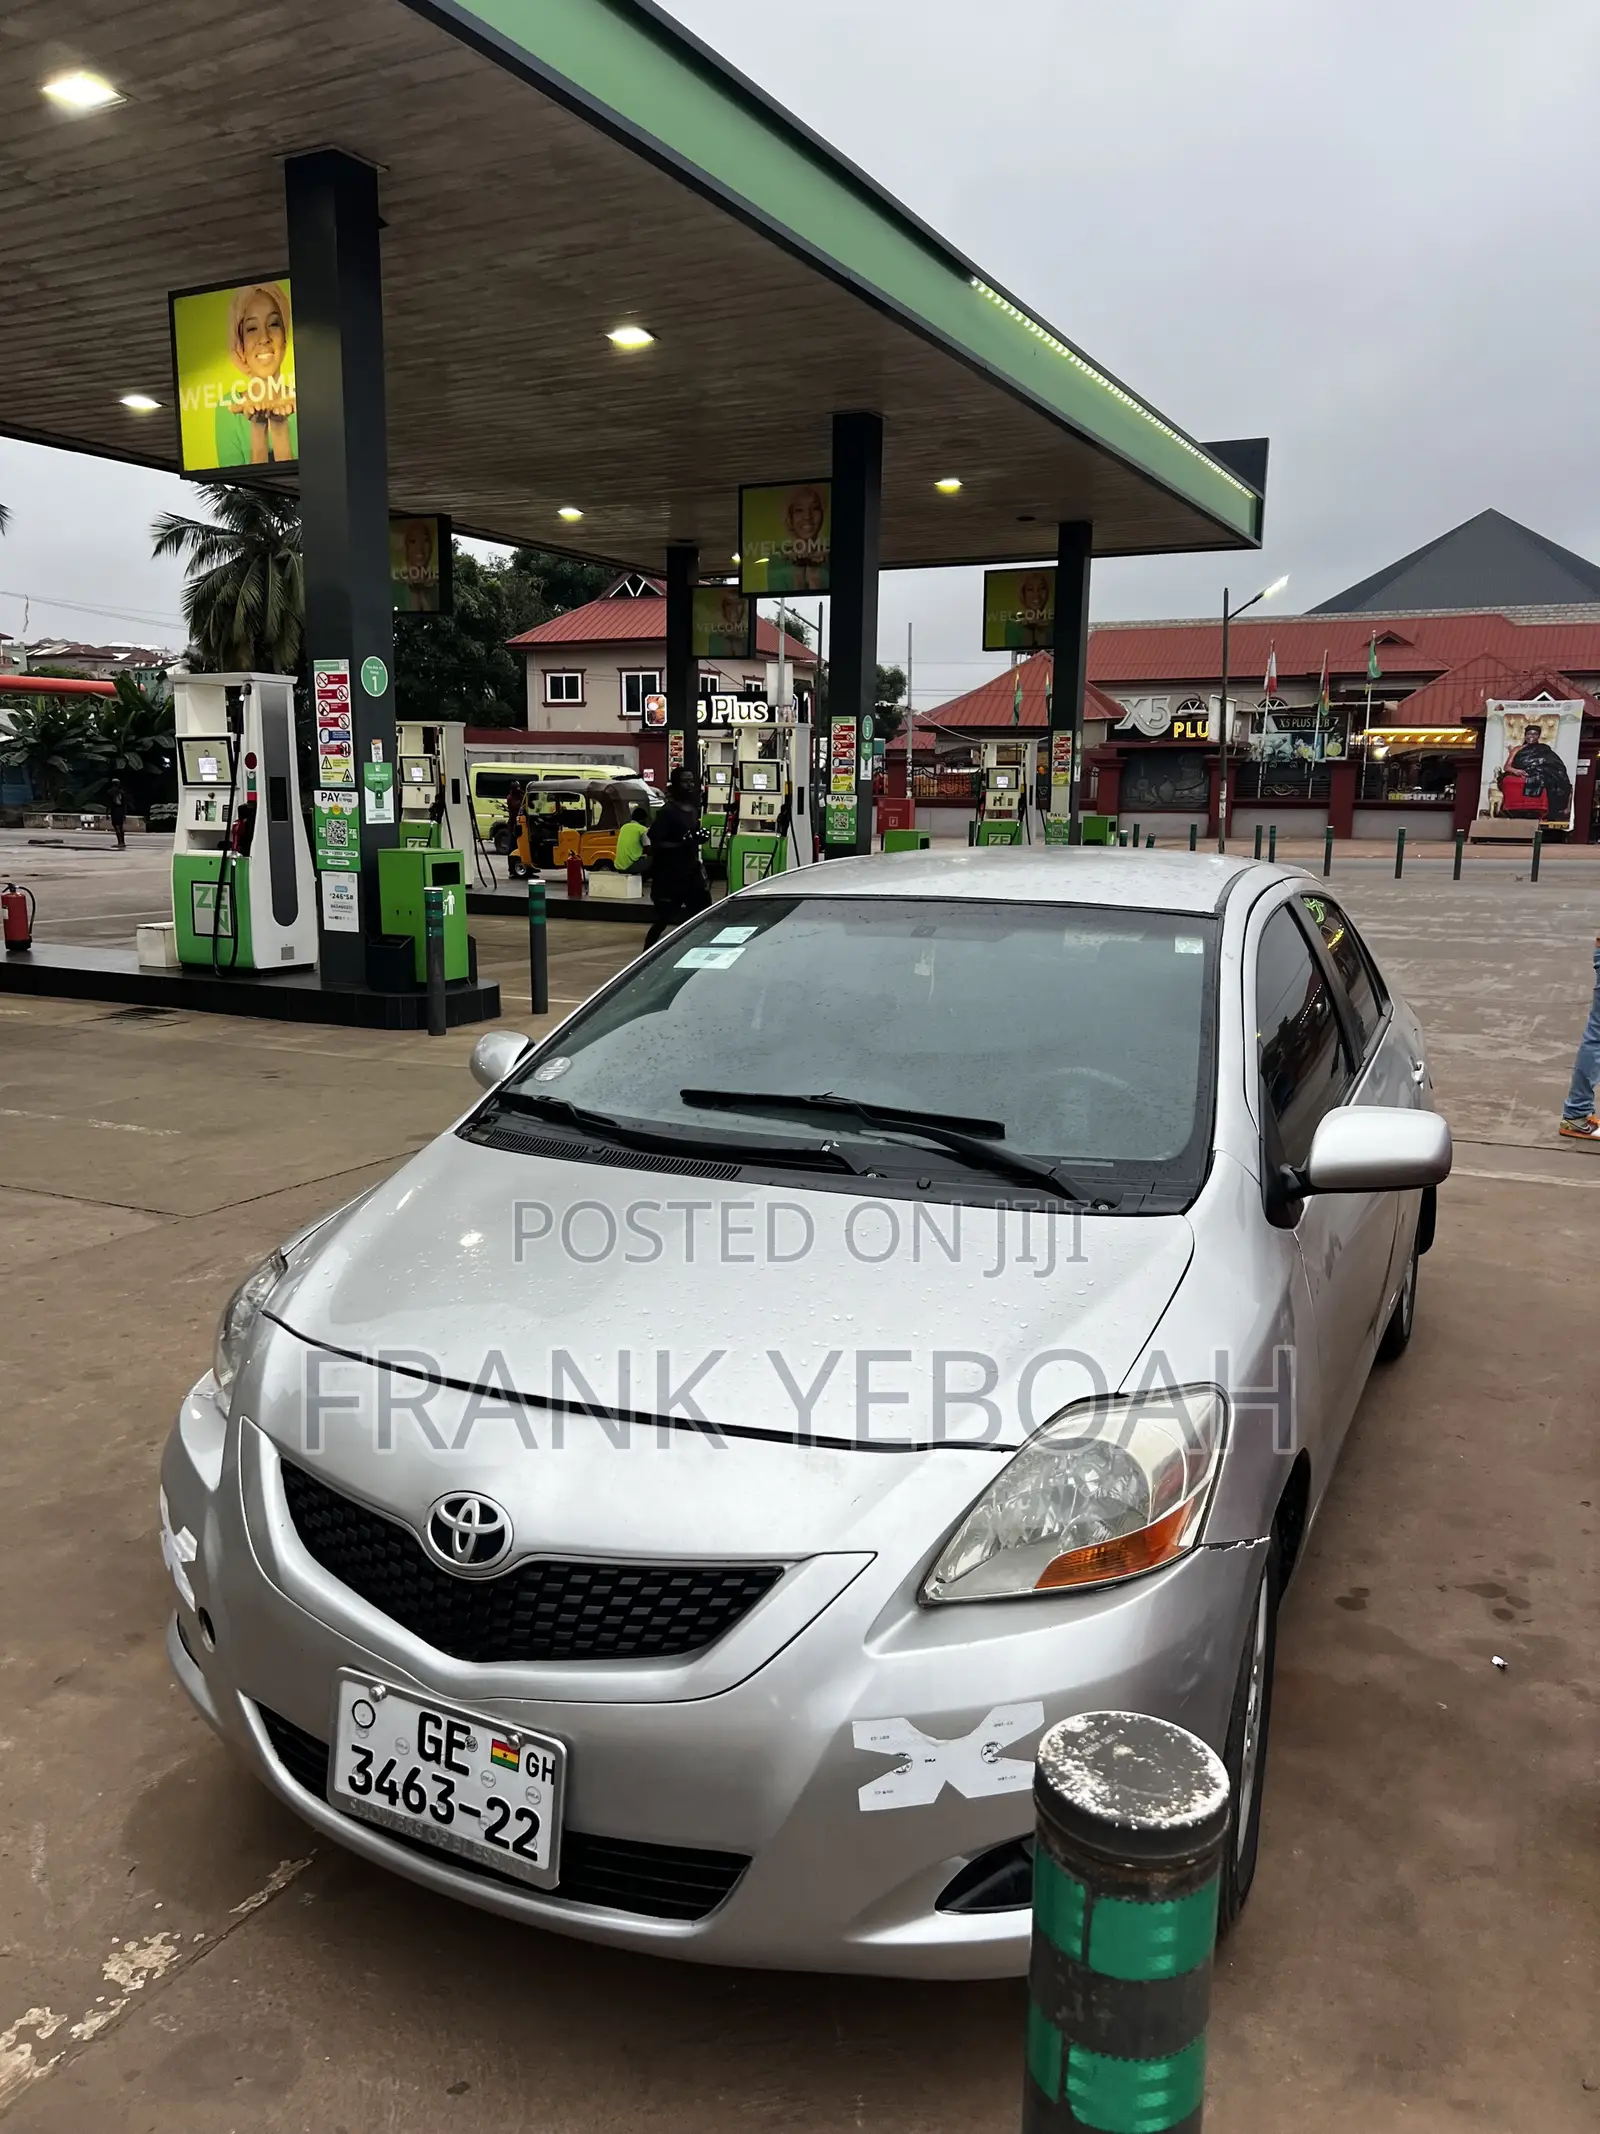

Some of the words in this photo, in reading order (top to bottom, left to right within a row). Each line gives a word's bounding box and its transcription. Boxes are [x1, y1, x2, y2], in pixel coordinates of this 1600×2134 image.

[372, 675, 378, 692] 1
[711, 696, 769, 723] Plus
[1114, 695, 1172, 737] X5
[1173, 721, 1209, 738] PLU
[1280, 718, 1290, 728] X5
[1291, 718, 1311, 728] PLUS
[321, 792, 340, 802] PAY
[745, 854, 770, 868] ZE
[417, 1711, 472, 1777] GE
[525, 1751, 556, 1786] GH
[348, 1744, 541, 1862] 3463-22
